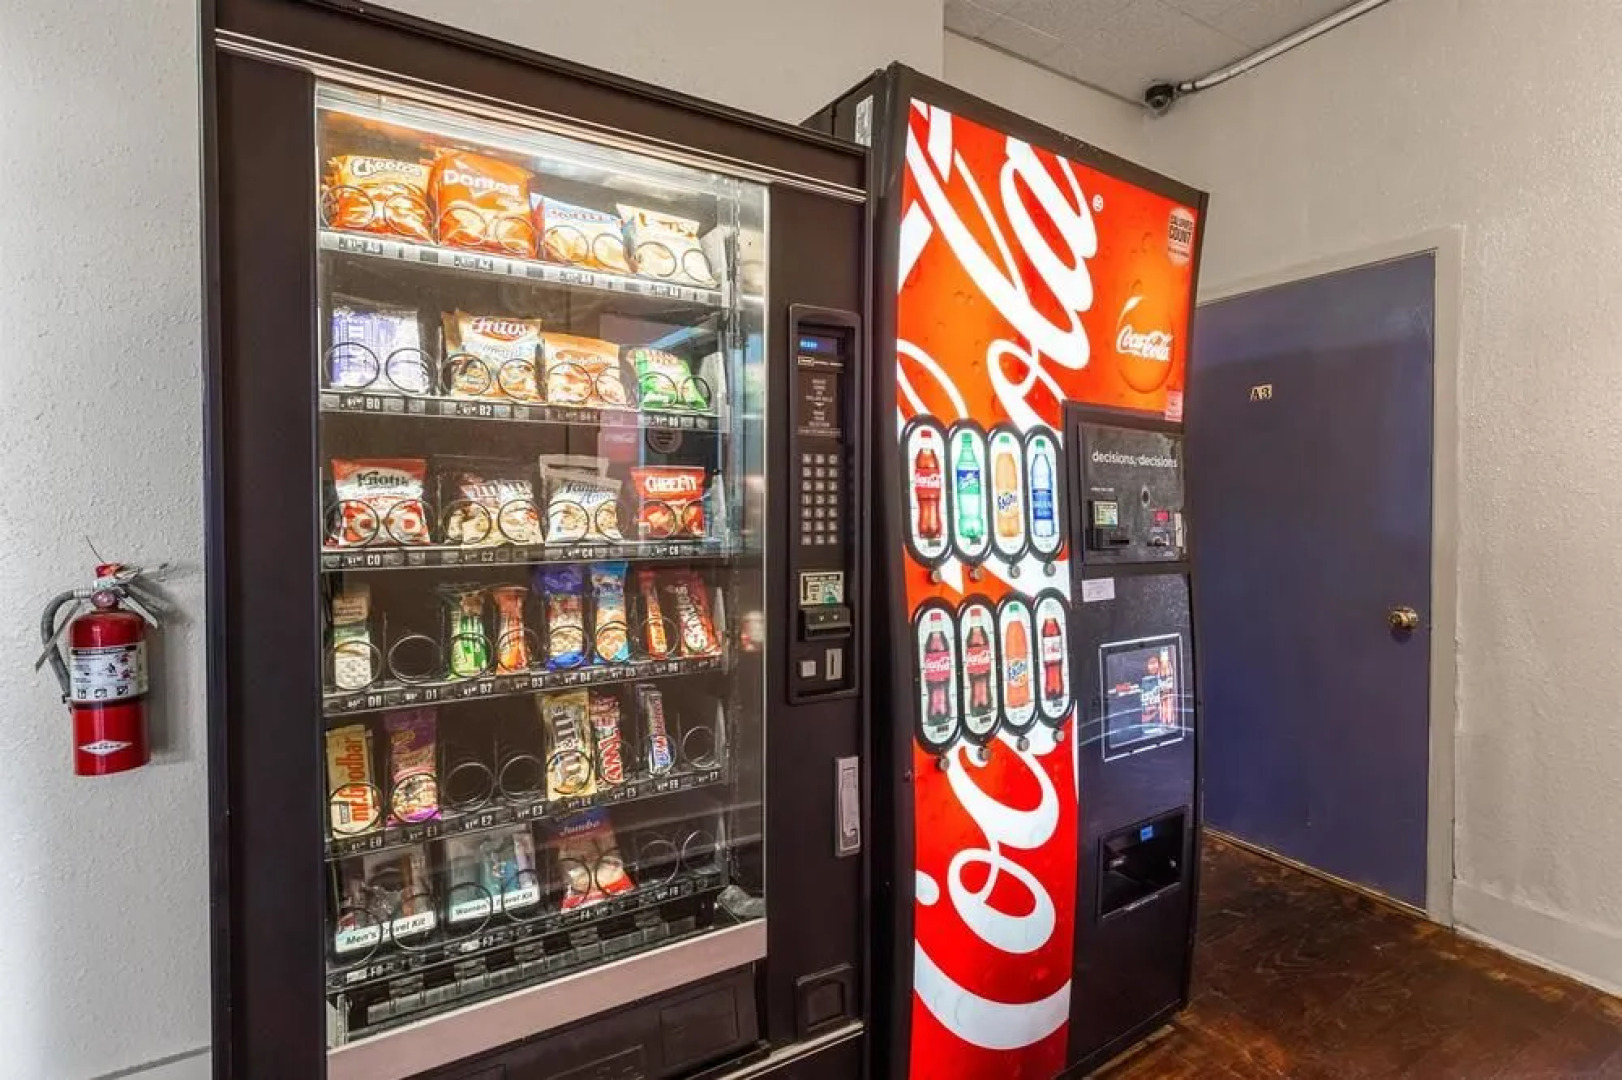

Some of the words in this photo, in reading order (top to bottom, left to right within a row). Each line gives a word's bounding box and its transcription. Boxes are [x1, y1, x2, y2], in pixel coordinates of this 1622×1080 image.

[350, 157, 423, 178] Cheetos
[444, 169, 521, 197] Doritos
[1169, 225, 1191, 244] COUNT
[471, 317, 529, 335] Fritos
[1116, 324, 1173, 361] Coca-Cola
[1091, 450, 1136, 466] decisions,
[559, 820, 600, 837] Jumbo
[455, 899, 493, 915] Women'
[346, 931, 377, 945] Men's
[411, 917, 426, 928] Kit
